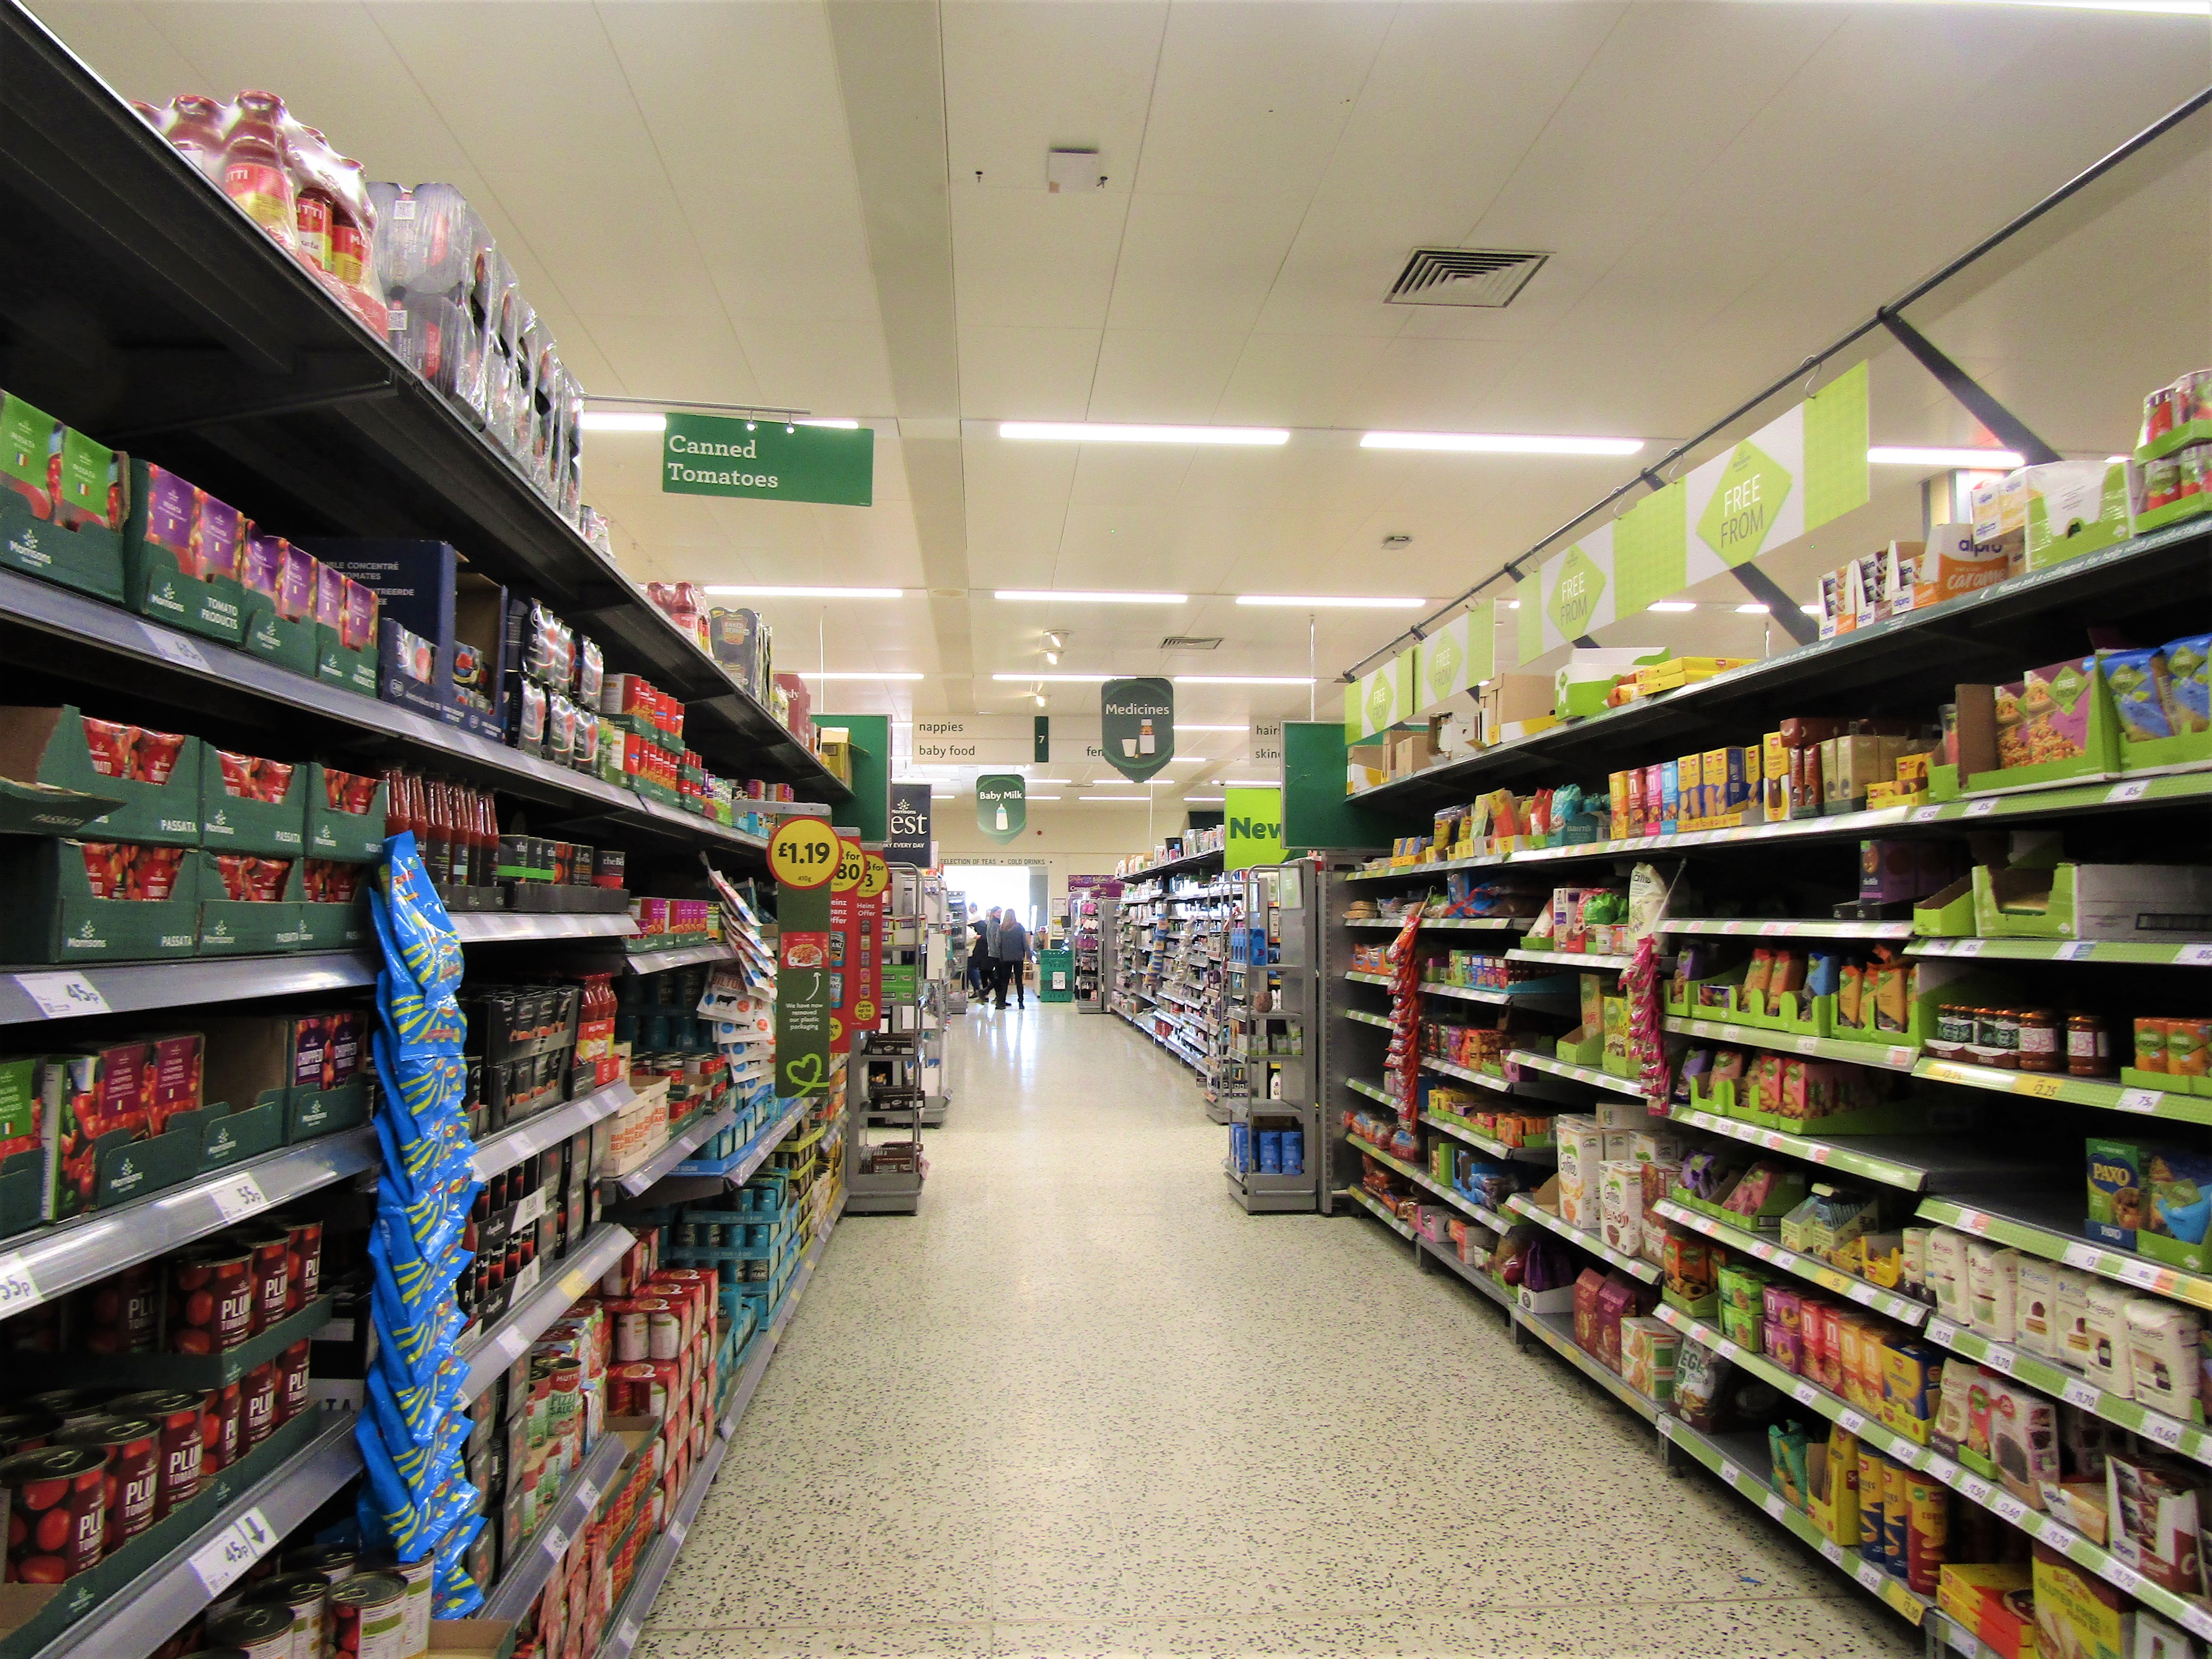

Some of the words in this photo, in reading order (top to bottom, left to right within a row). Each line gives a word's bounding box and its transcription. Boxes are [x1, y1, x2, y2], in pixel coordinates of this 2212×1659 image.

[669, 435, 757, 459] Canned
[668, 462, 779, 489] Tomatoes
[1723, 474, 1761, 517] FREE
[1720, 503, 1764, 549] FROM
[9, 539, 52, 564] Morrisons
[1959, 533, 2002, 557] alpro
[347, 562, 399, 570] CONCENTRÉ
[1994, 580, 2021, 595] Please
[2020, 575, 2036, 586] ask
[2041, 559, 2084, 581] colleague
[2082, 554, 2101, 566] for
[2099, 547, 2124, 562] help
[2123, 540, 2147, 553] with
[2145, 524, 2195, 550] products
[1562, 571, 1585, 601] FREE
[151, 593, 185, 612] Morrisons
[207, 596, 238, 617] TOMATO
[1559, 597, 1588, 626] FROM
[201, 608, 238, 630] PRODUCTS
[1435, 647, 1451, 668] FREE
[1434, 665, 1452, 688] FROM
[787, 689, 799, 701] sly
[1373, 687, 1386, 703] FREE
[1105, 703, 1170, 715] Medicines
[1373, 705, 1387, 722] FROM
[919, 722, 963, 733] nappies
[1256, 725, 1281, 735] hair
[1038, 735, 1045, 744] 7
[919, 745, 946, 758] baby
[949, 745, 975, 756] food
[979, 791, 1002, 800] Baby
[1003, 790, 1022, 800] Milk
[160, 819, 198, 833] PASSATA
[890, 813, 928, 835] est
[778, 842, 830, 864] £1.19
[846, 851, 860, 860] for
[836, 864, 860, 880] 80
[863, 874, 873, 887] 3
[67, 937, 107, 948] Morrisons
[161, 935, 193, 947] PASSATA
[65, 983, 99, 1004] 45p
[110, 1171, 143, 1190] Morrisons
[2093, 1162, 2130, 1187] PAXO
[236, 1185, 261, 1205] 55p
[225, 1540, 250, 1564] 45p
